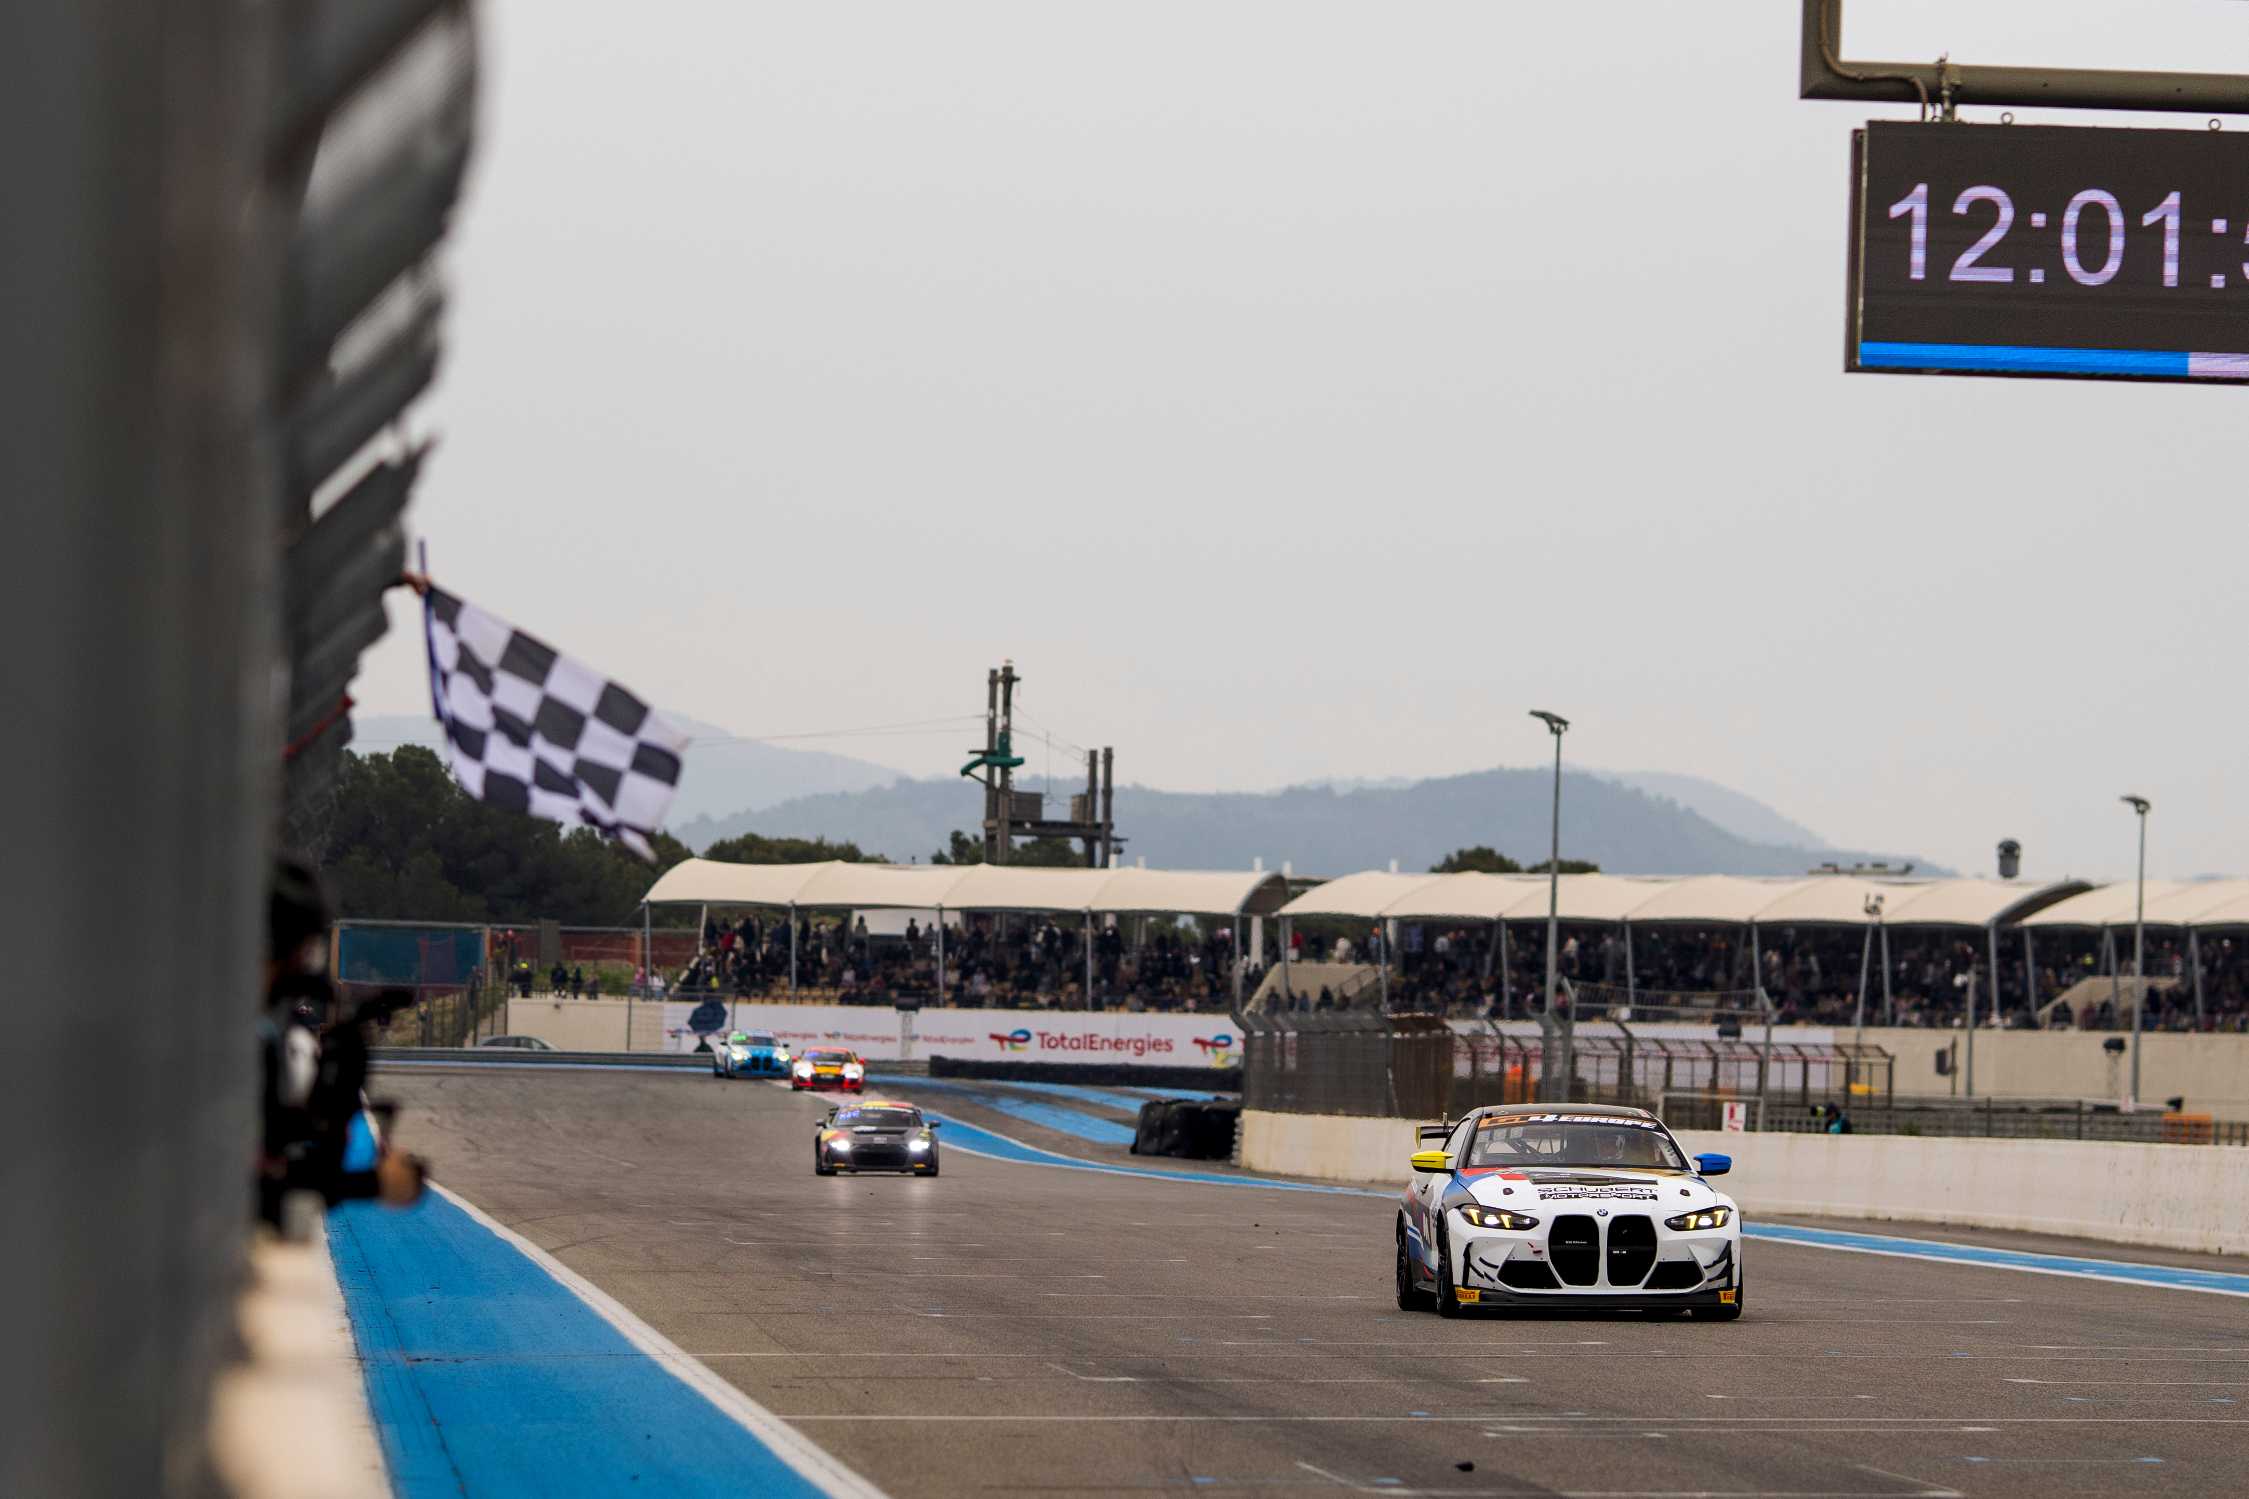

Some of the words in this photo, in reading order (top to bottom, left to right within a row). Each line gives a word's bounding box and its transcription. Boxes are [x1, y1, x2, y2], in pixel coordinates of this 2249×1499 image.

[1889, 183, 2249, 288] 12:01:
[1037, 1031, 1174, 1056] TotalEnergies
[1558, 1114, 1657, 1130] EUROPE
[1537, 1186, 1658, 1194] SCHUBERT
[1542, 1192, 1656, 1200] MOTORSPORT
